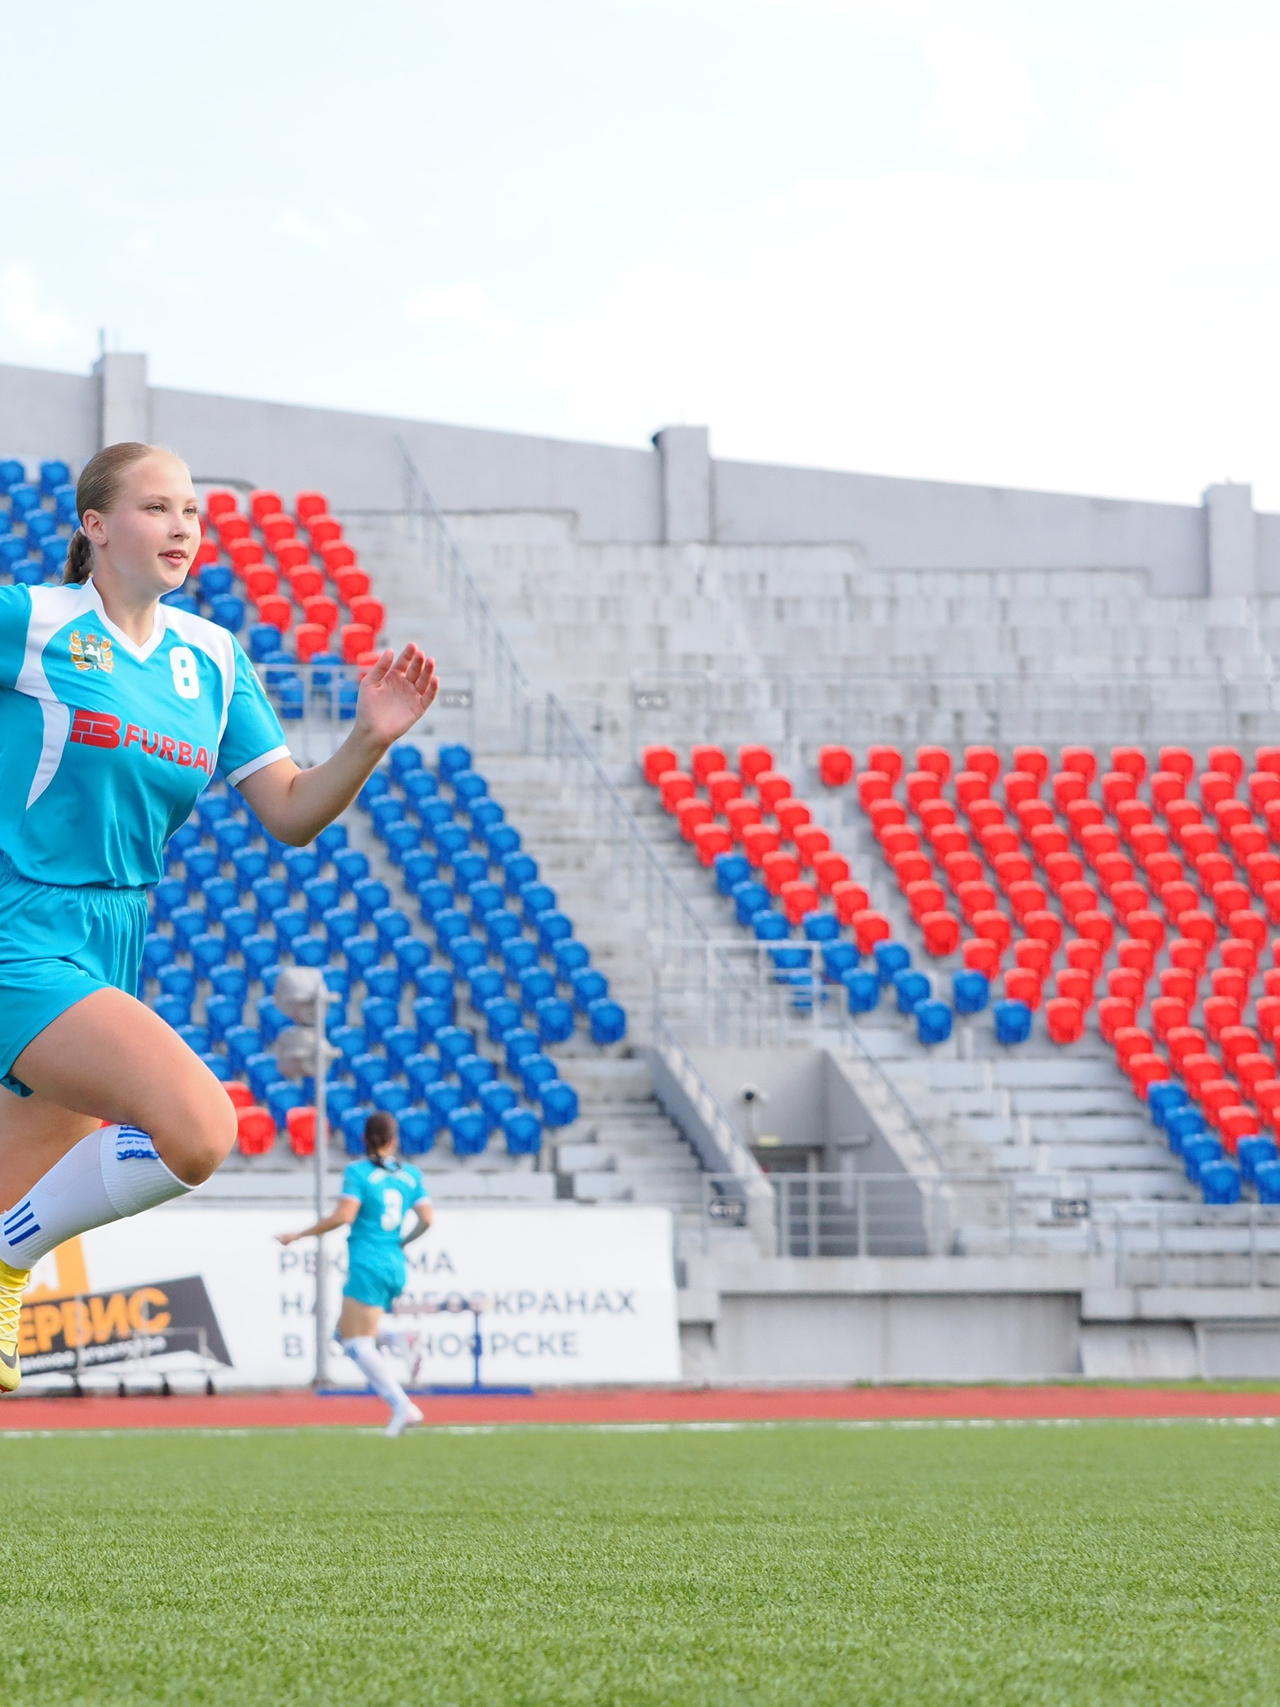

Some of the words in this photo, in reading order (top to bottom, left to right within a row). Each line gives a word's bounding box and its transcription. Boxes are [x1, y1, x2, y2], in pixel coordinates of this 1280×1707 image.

[169, 646, 200, 700] 8
[19, 1287, 172, 1355] ЕРВИС
[285, 1335, 302, 1357] В
